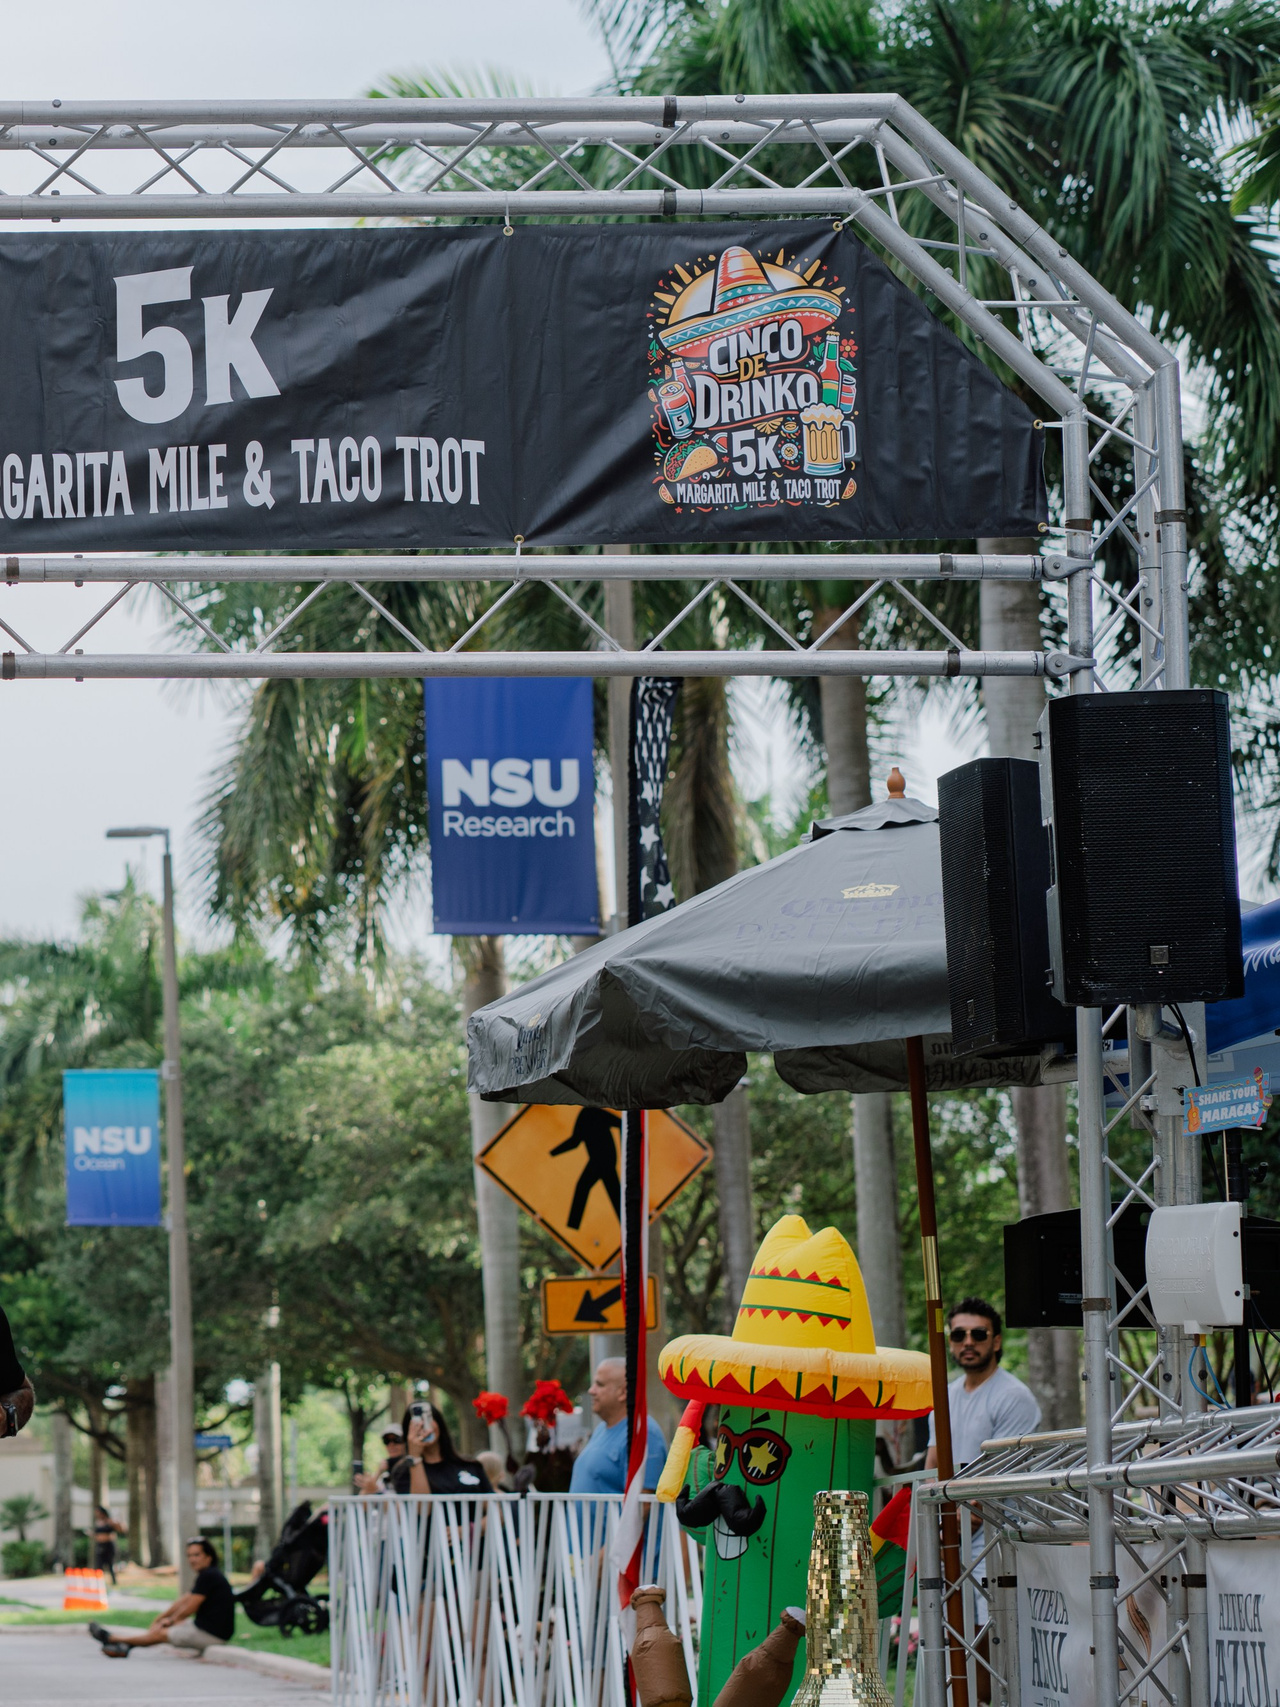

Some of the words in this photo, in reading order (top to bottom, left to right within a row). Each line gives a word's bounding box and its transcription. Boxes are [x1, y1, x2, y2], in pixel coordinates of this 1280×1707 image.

[113, 265, 282, 424] 5K
[709, 320, 803, 375] CINCO
[738, 353, 767, 382] DE
[692, 373, 819, 428] DRINKO
[676, 415, 685, 427] 5
[731, 430, 781, 477] 5K
[148, 443, 228, 514] MILE
[242, 440, 274, 510] &
[291, 435, 382, 504] TACO
[395, 436, 486, 505] TROT
[676, 480, 739, 504] MARGARITA
[742, 480, 767, 501] MILE
[770, 482, 780, 500] &
[784, 479, 812, 500] TACO
[815, 478, 841, 500] TROT
[441, 758, 580, 808] NSU
[443, 810, 575, 837] Research
[1198, 1089, 1231, 1106] SHAKE
[1231, 1085, 1258, 1100] YOUR
[1202, 1101, 1260, 1123] MARACAS
[73, 1126, 152, 1155] NSU
[74, 1155, 126, 1171] Ocean
[1218, 1593, 1263, 1633] AZTECA
[1214, 1640, 1280, 1707] AZUL
